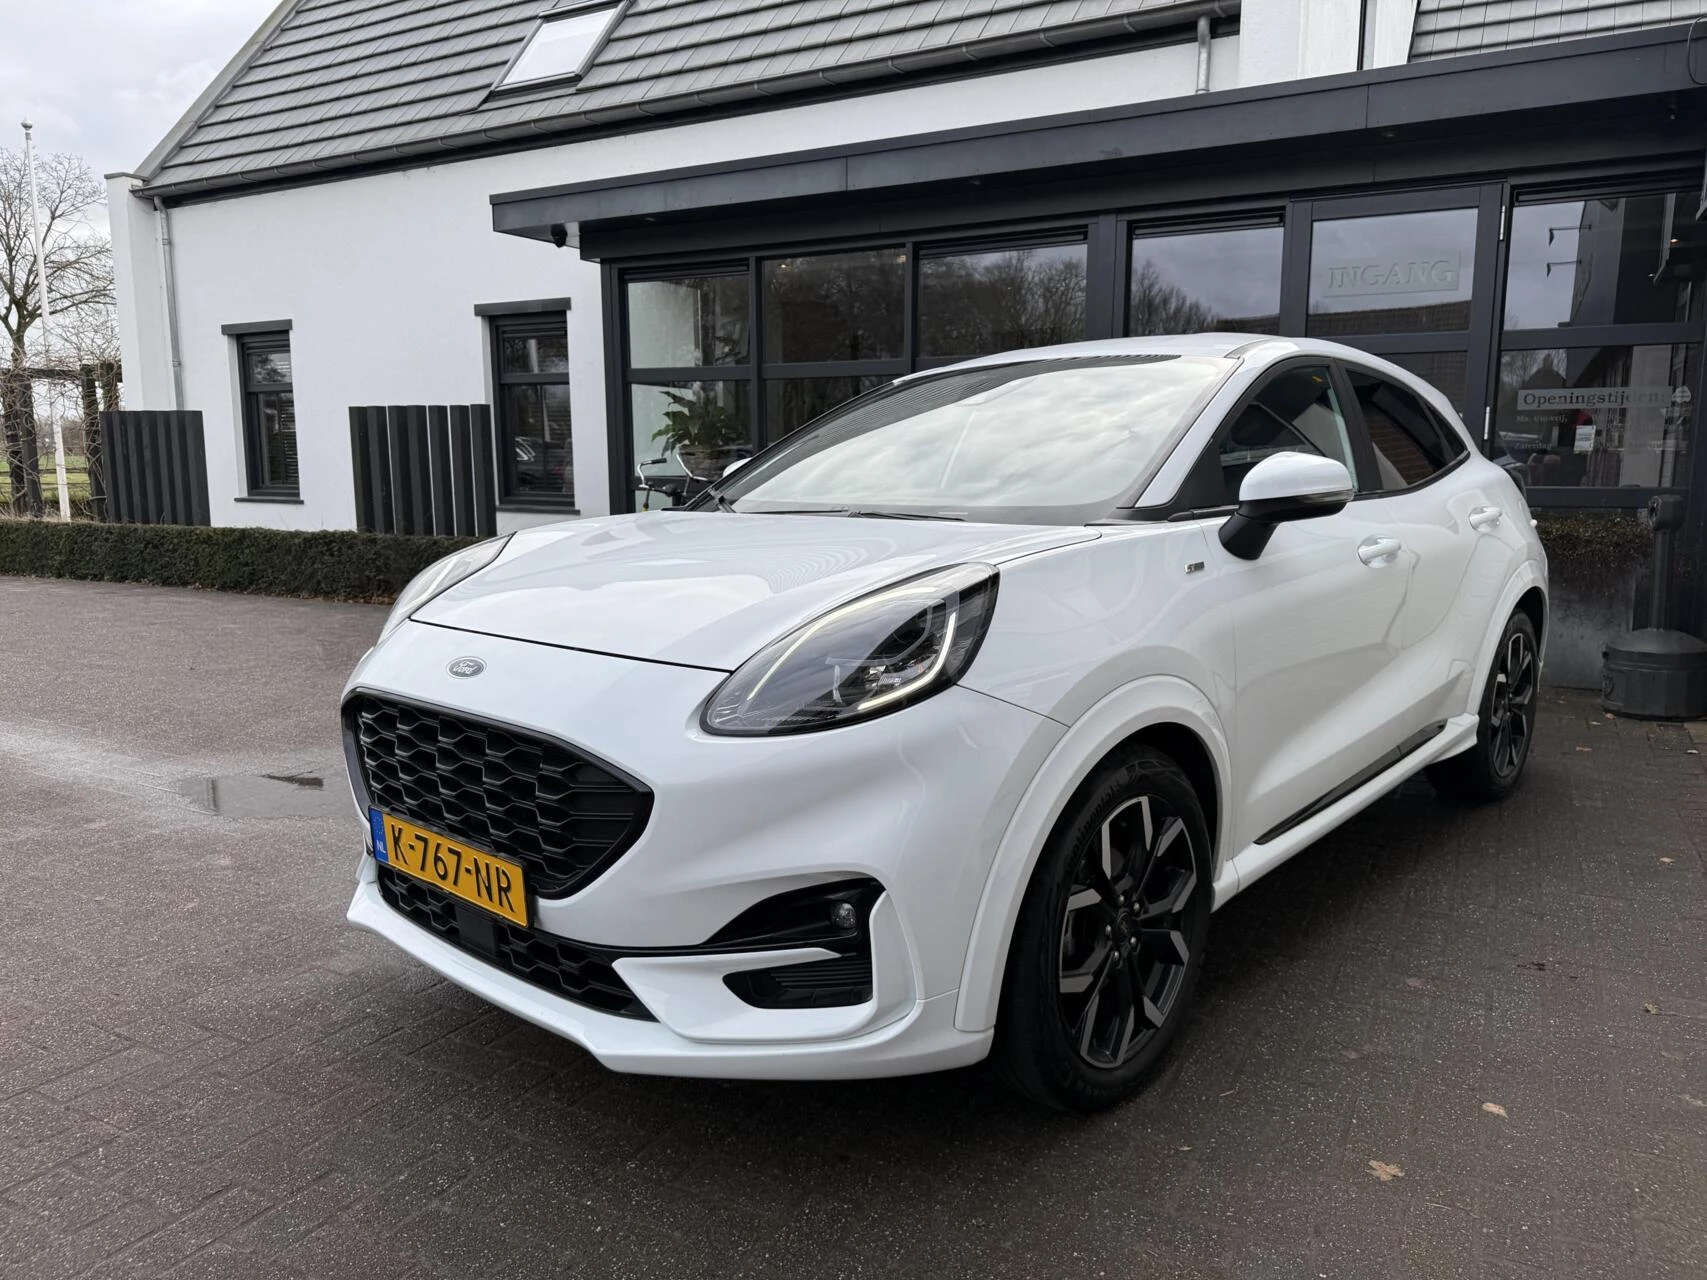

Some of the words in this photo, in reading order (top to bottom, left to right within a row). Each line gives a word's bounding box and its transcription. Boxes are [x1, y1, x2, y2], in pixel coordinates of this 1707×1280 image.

[1328, 259, 1454, 289] INGANG
[452, 660, 478, 675] Ford
[376, 840, 387, 854] NL
[390, 823, 516, 914] K-767-NR
